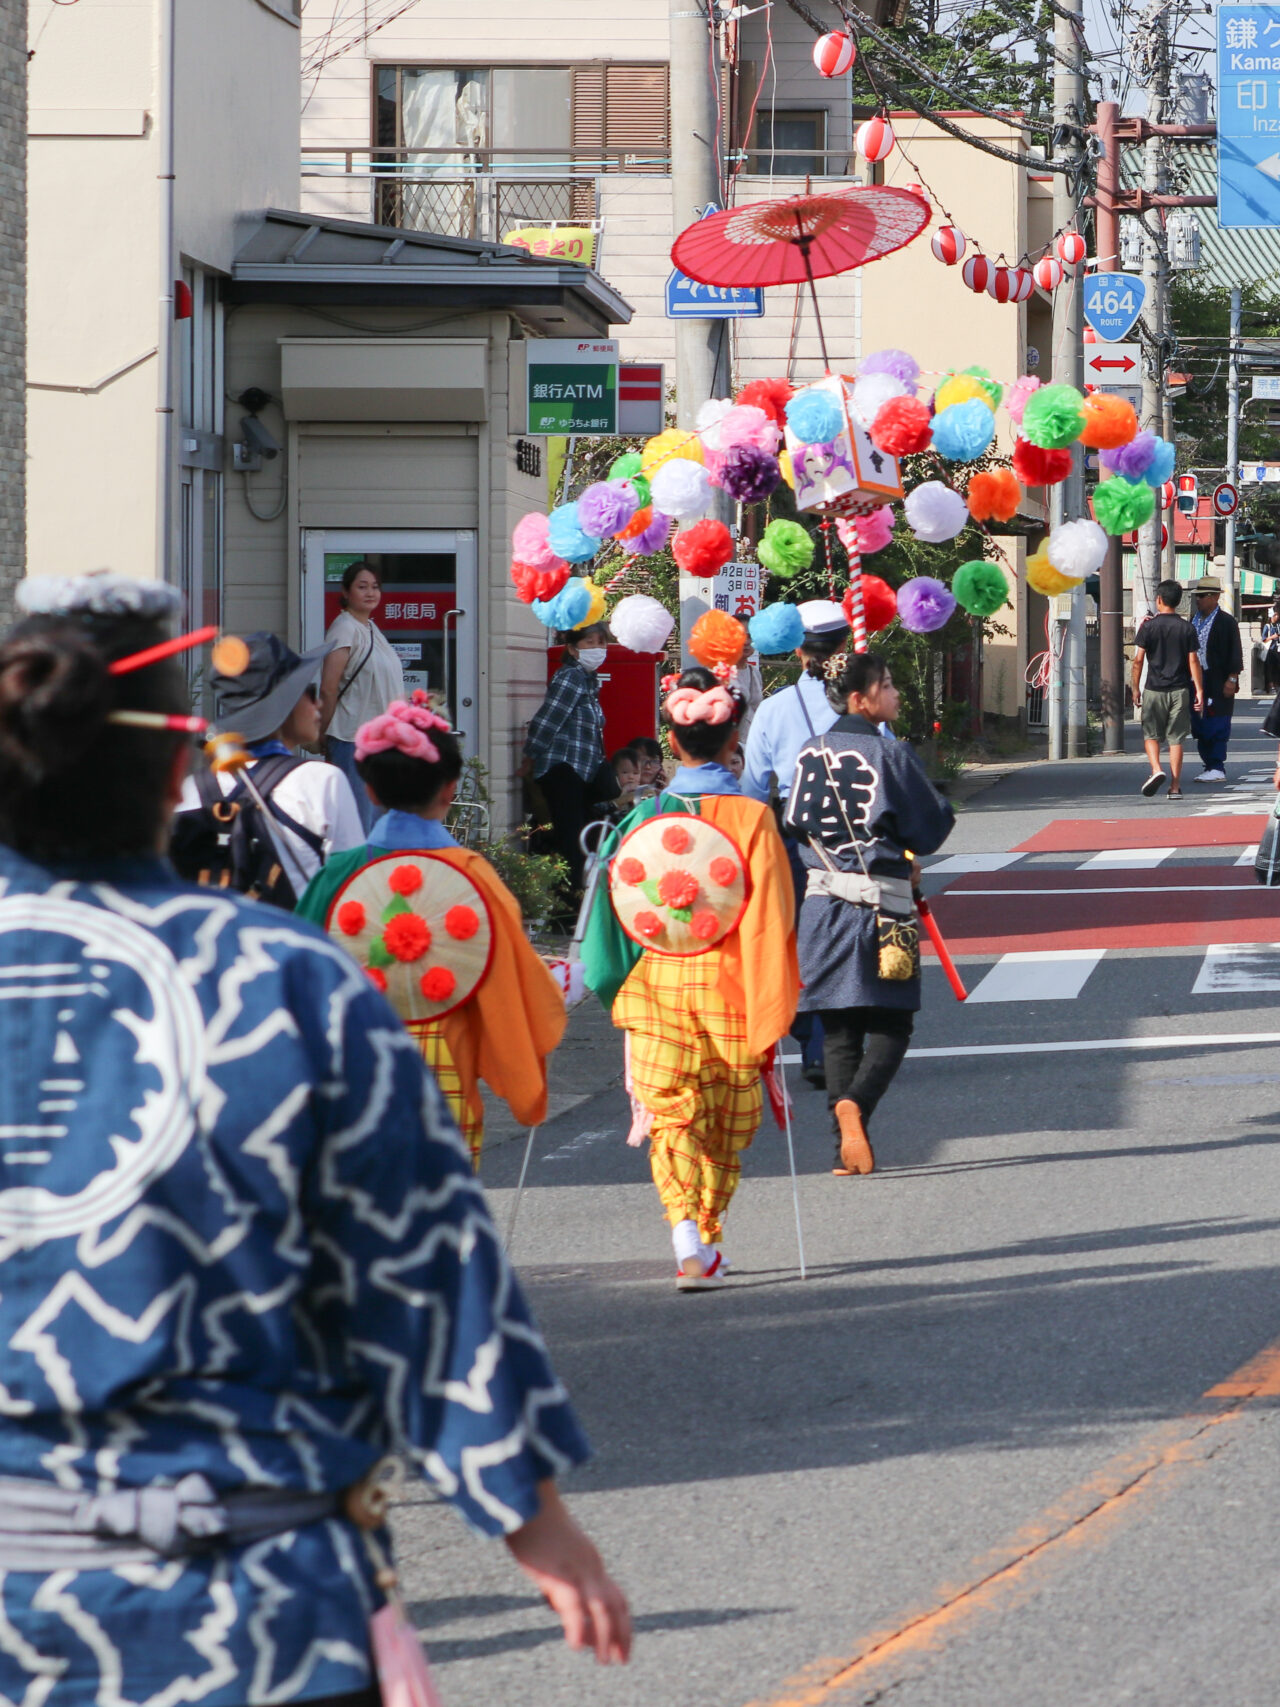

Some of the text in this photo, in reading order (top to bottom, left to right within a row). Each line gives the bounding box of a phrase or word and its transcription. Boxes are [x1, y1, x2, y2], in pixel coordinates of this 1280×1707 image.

[1098, 277, 1124, 287] 国道
[1088, 290, 1135, 315] 464
[1100, 318, 1123, 326] ROUTE
[533, 384, 603, 398] 銀行ATM
[559, 418, 608, 428] ゆうちょ銀行
[717, 566, 756, 577] 月2日(土)
[385, 603, 436, 619] 郵便局
